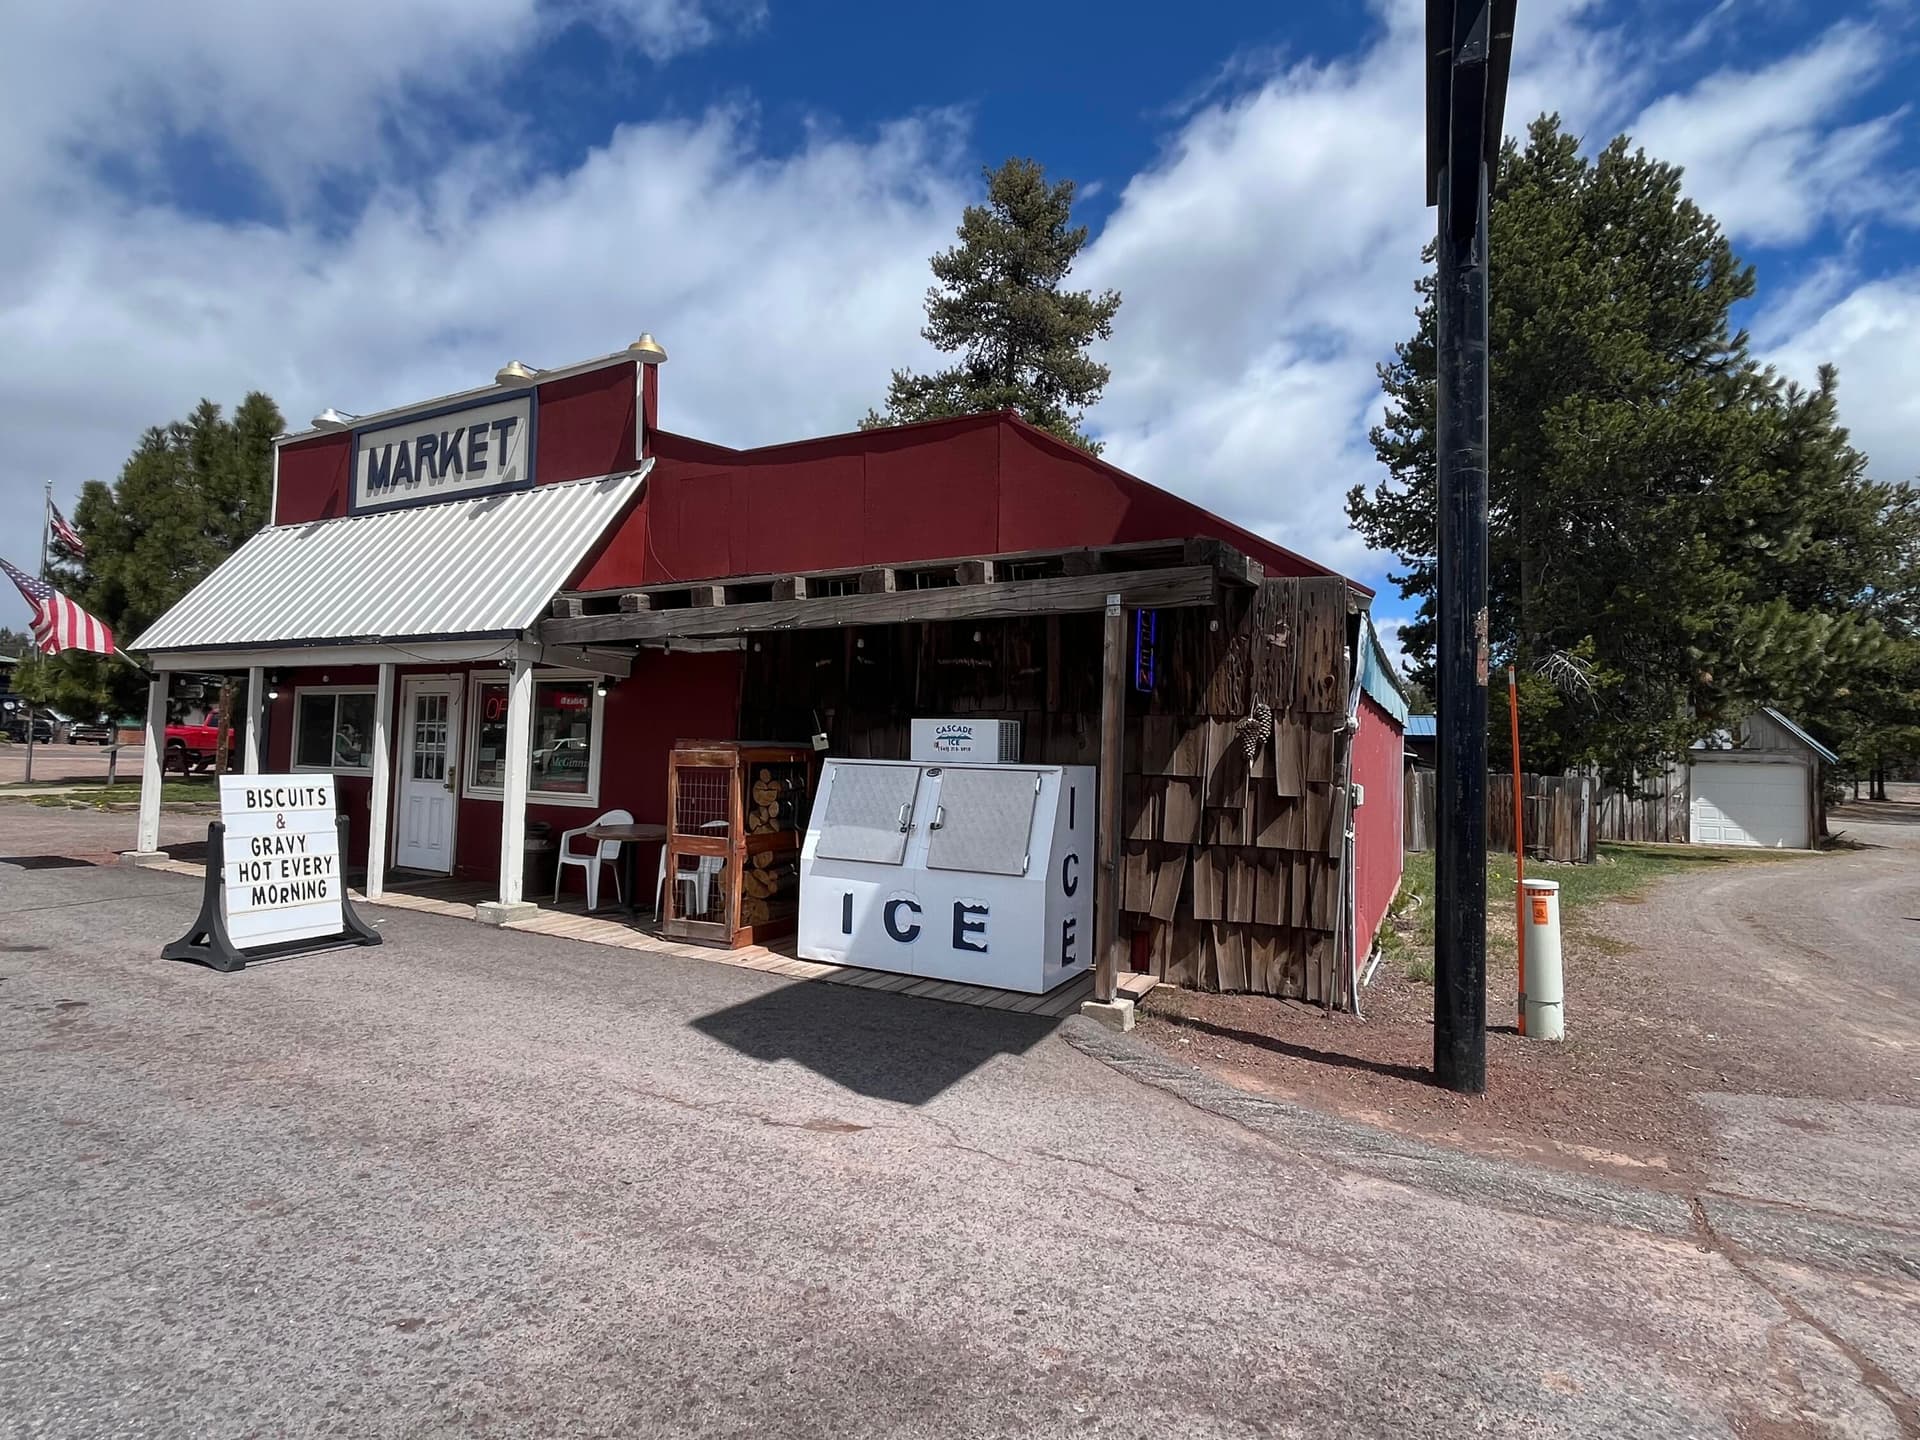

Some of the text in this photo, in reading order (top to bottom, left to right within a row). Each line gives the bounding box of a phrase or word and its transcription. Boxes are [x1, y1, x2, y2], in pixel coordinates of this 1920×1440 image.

[367, 416, 518, 490] MARKET
[935, 724, 973, 736] CASCADE
[948, 738, 960, 746] ICE
[246, 787, 327, 809] BISCUITS
[276, 813, 286, 830] &
[251, 834, 306, 857] GRAVY
[238, 856, 332, 883] HOT EVERY
[1062, 785, 1079, 968] ICE
[251, 879, 327, 906] MORNING
[842, 889, 990, 953] ICE
